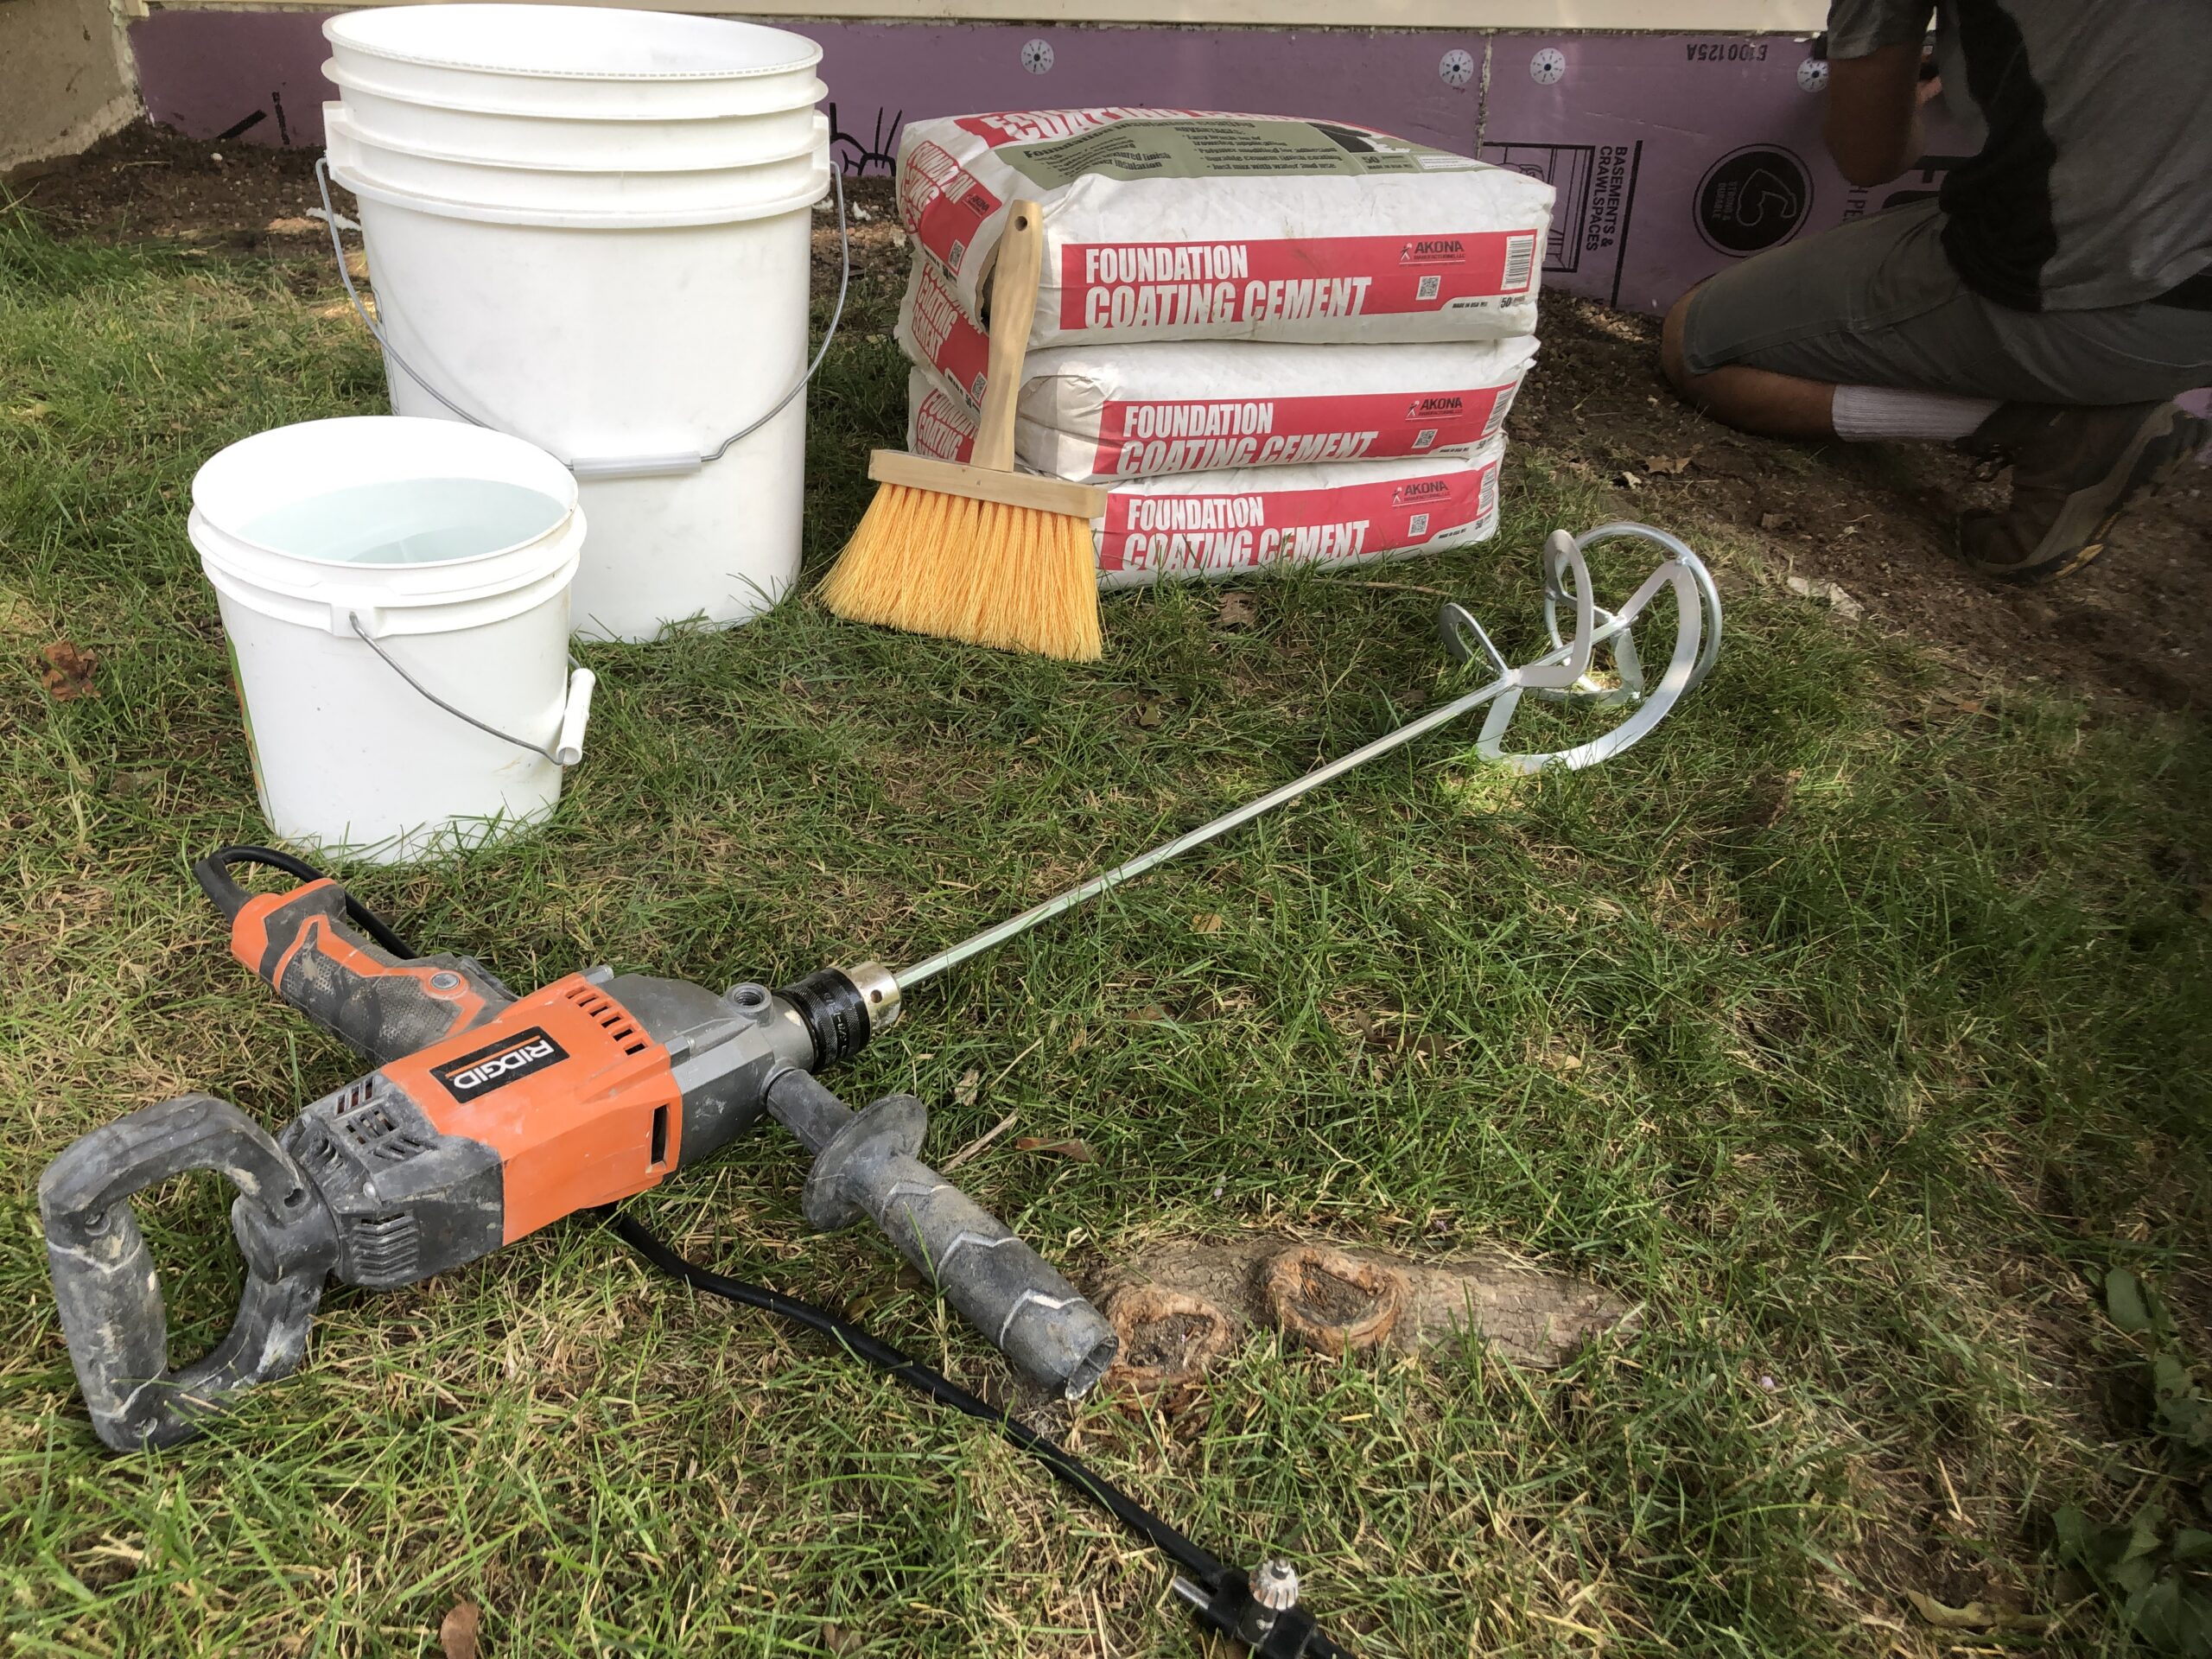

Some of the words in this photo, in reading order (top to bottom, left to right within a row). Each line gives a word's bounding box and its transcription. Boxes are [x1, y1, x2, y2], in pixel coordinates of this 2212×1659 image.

[1023, 128, 1114, 158] Foundation
[1586, 145, 1613, 251] CRAWLSPACES
[1603, 146, 1628, 234] BASEMENTS
[1713, 182, 1726, 219] DURABLE
[1414, 240, 1465, 254] AKONA
[1600, 238, 1614, 247] &
[1085, 245, 1249, 283] FOUNDATION
[917, 275, 958, 341] COATING
[1084, 281, 1237, 328] COATING
[1242, 276, 1372, 322] CEMENT
[1500, 296, 1512, 308] 50
[912, 304, 944, 365] CEMENT
[1123, 402, 1274, 438] FOUNDATION
[1420, 397, 1463, 410] AKONA
[918, 410, 963, 463] COATING
[1116, 436, 1258, 475] COATING
[1255, 430, 1379, 467] CEMENT
[1404, 480, 1449, 496] AKONA
[1127, 496, 1264, 531] FOUNDATION
[1122, 529, 1254, 571] COATING
[1258, 519, 1370, 563] CEMENT
[454, 1039, 555, 1090] RIDGID
